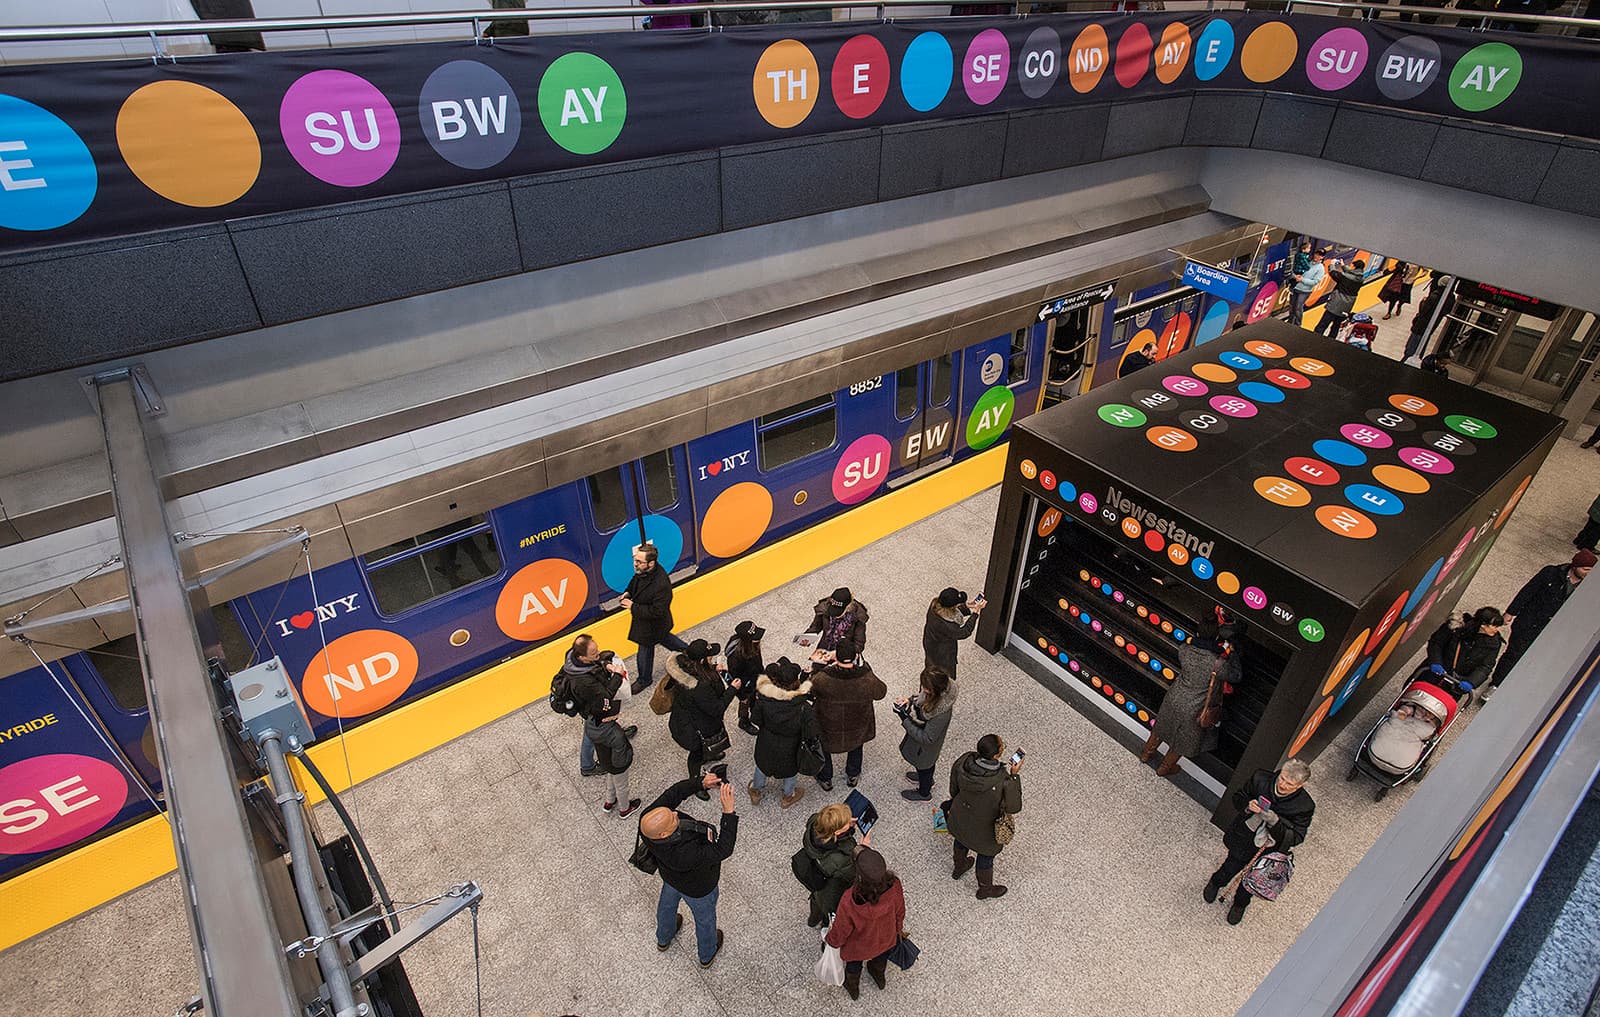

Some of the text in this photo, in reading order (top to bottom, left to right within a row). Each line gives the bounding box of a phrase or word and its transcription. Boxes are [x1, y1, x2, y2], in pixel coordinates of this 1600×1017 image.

[767, 40, 1509, 102] TH E SE CO ND AV E SU BW AY
[0, 87, 607, 190] E SU BW AY
[1194, 274, 1211, 286] Area
[1196, 265, 1229, 283] Boarding
[1252, 296, 1273, 318] SE
[849, 375, 882, 396] 8852
[1173, 380, 1197, 392] SU
[1141, 393, 1170, 408] BW
[1158, 362, 1324, 446] TH E SE CO ND
[1111, 409, 1133, 422] AY
[1266, 399, 1425, 498] TH E SE CO ND
[698, 450, 750, 481] I NY
[1332, 420, 1482, 531] AV E SU BW AY
[1042, 512, 1058, 529] AV
[1105, 486, 1215, 560] Newsstand
[519, 524, 567, 549] #MYRIDE
[1023, 463, 1320, 637] TH E SE CO ND AV E SU BW AY
[0, 403, 1006, 834] SE ND AV SU BW AY
[275, 618, 293, 637] I
